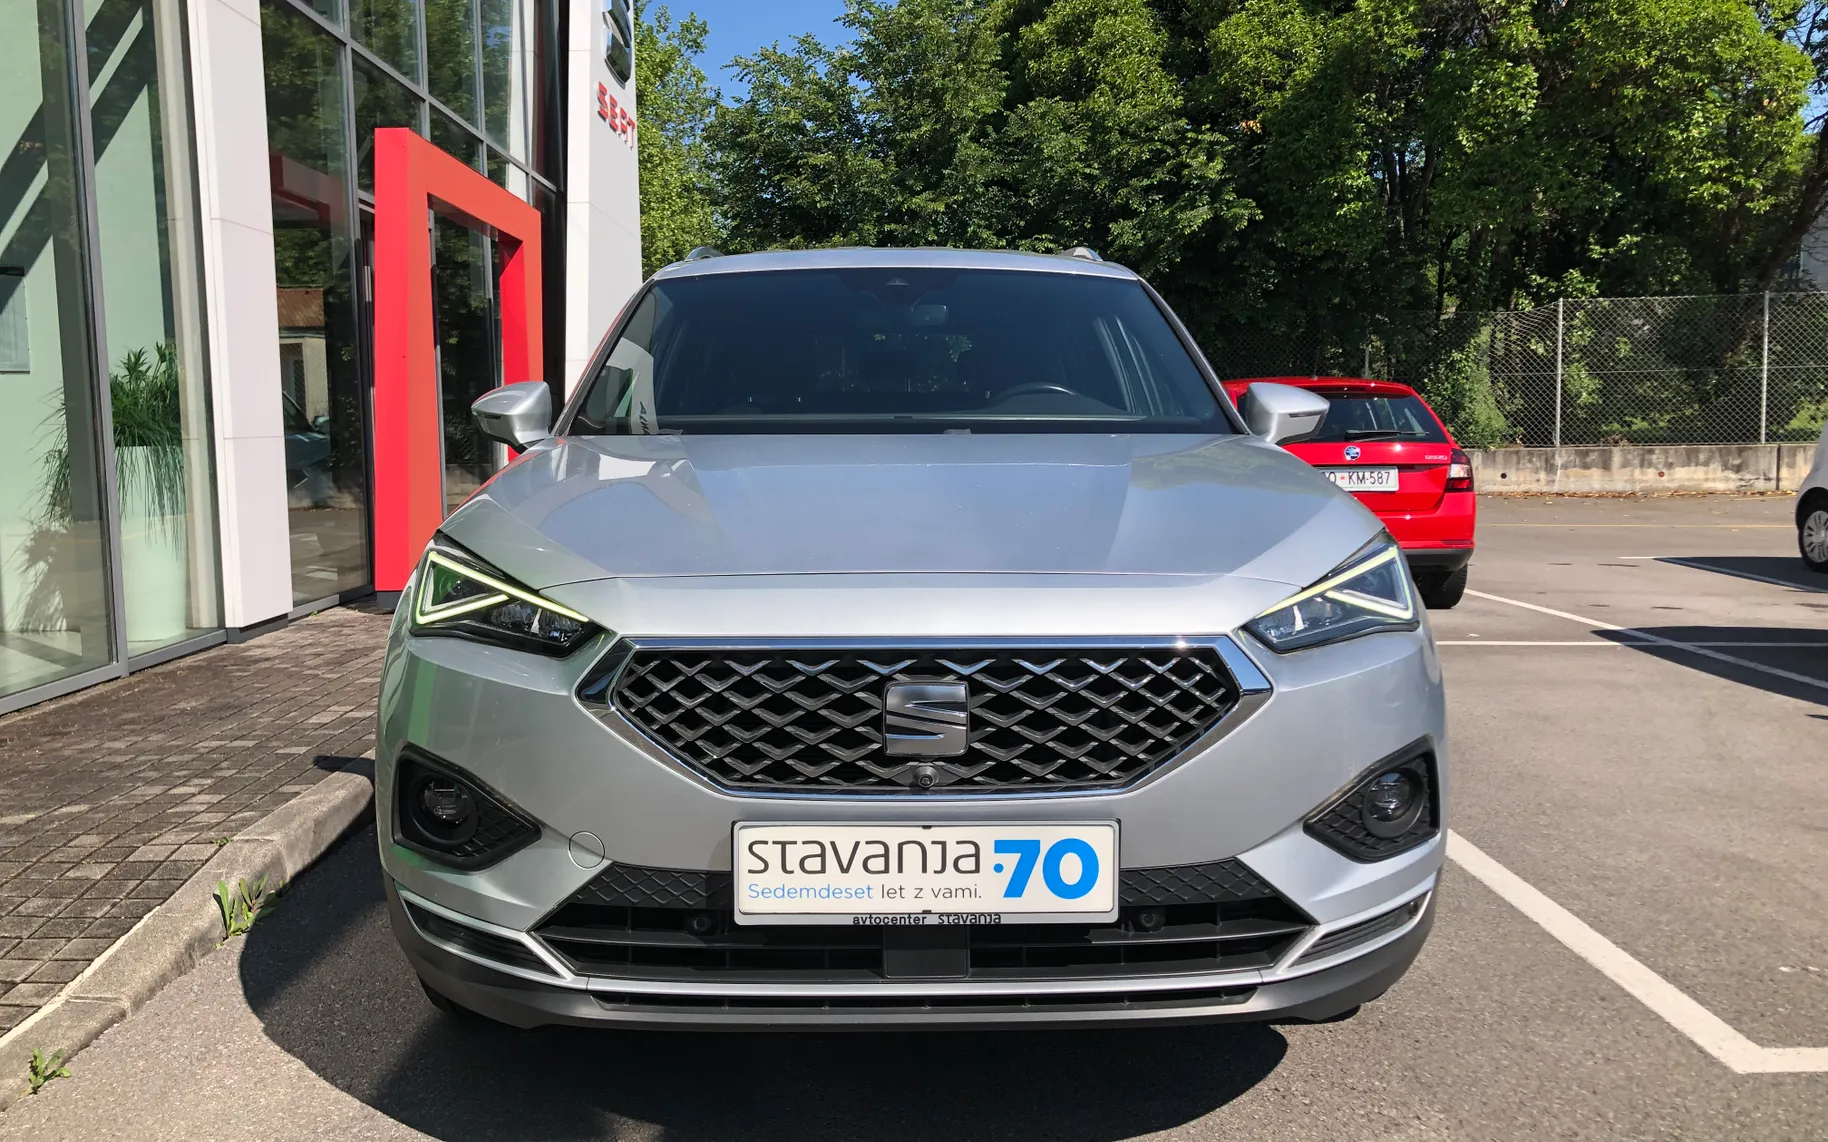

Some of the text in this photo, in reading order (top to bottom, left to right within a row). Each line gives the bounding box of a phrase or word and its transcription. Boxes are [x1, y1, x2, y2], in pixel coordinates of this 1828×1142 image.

[597, 81, 636, 150] SEAT
[747, 838, 981, 875] stavanja
[748, 883, 982, 900] Sedemdeset let z vami.
[852, 913, 1002, 925] avtocenter stavanja
